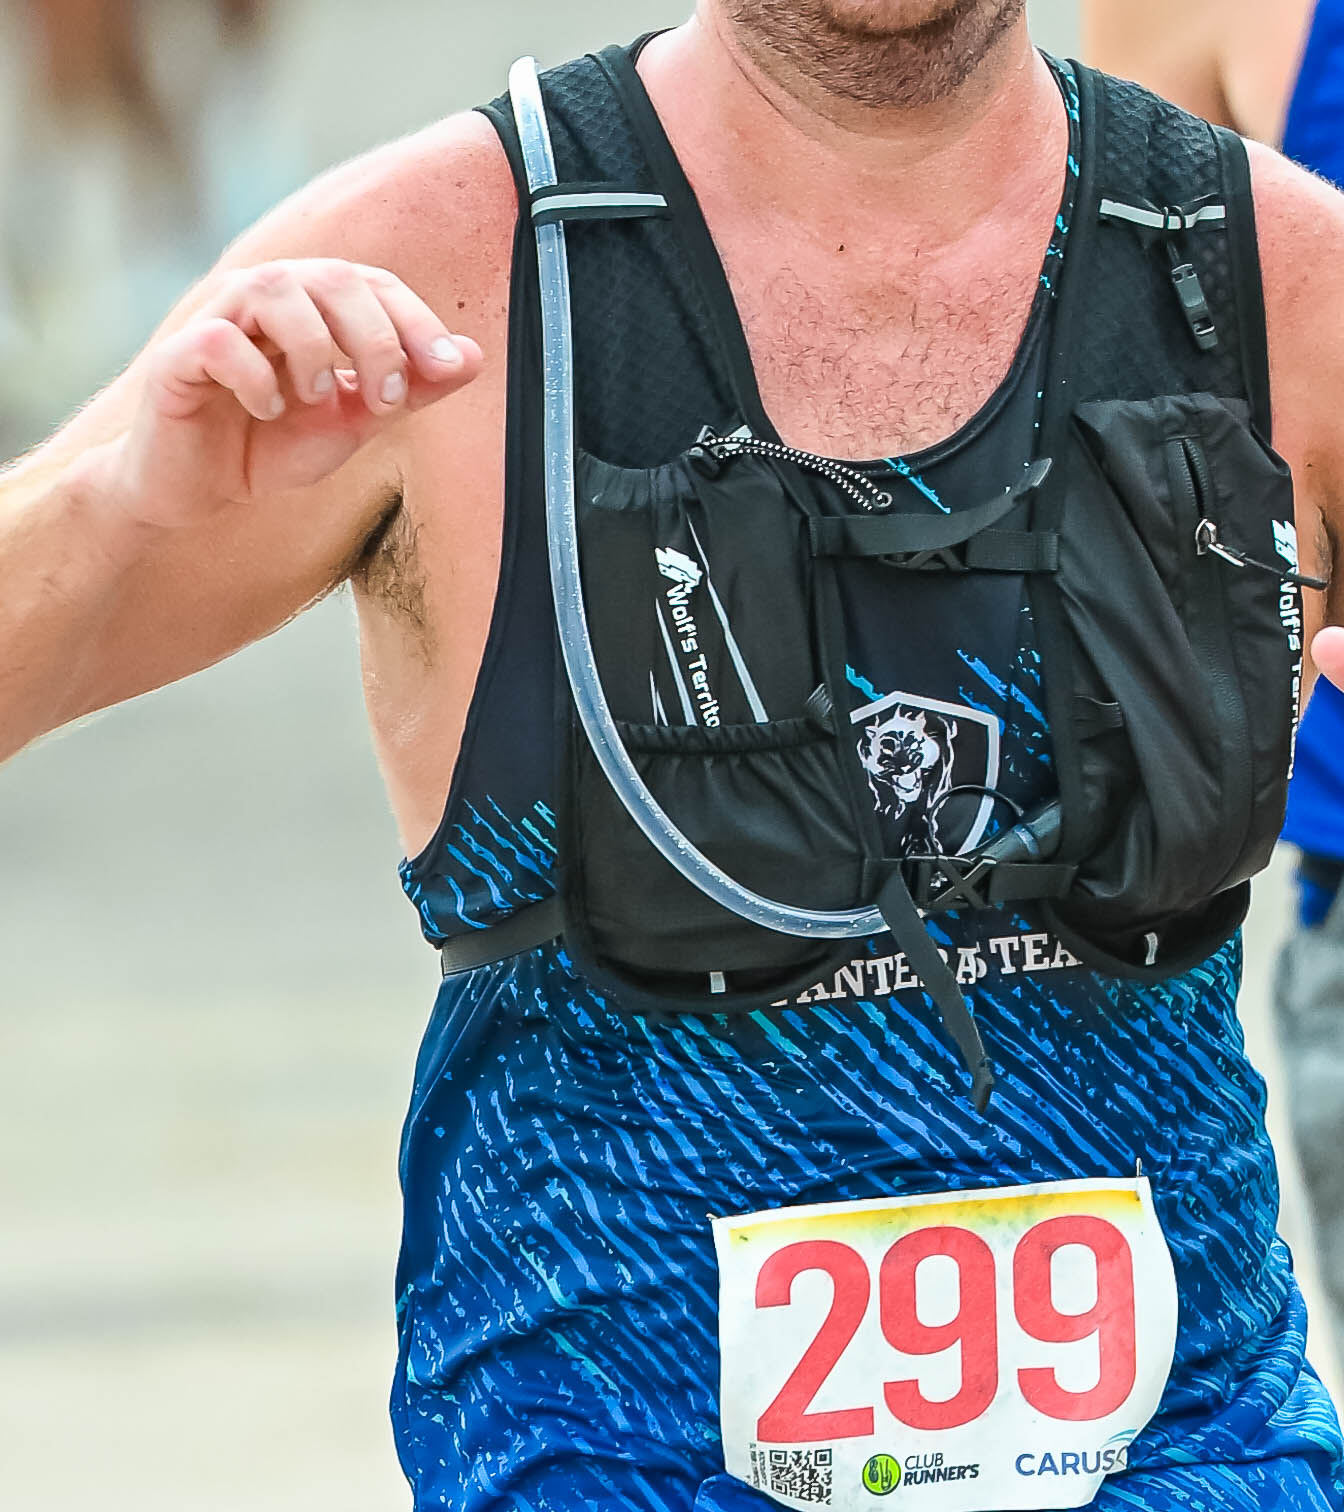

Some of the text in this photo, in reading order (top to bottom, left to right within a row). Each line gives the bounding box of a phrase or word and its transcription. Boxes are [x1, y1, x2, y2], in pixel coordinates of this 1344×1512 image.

[666, 584, 699, 653] Wolf's
[755, 1214, 1137, 1443] 299
[903, 1464, 980, 1487] RUNNER'S
[904, 1452, 944, 1470] CLUB
